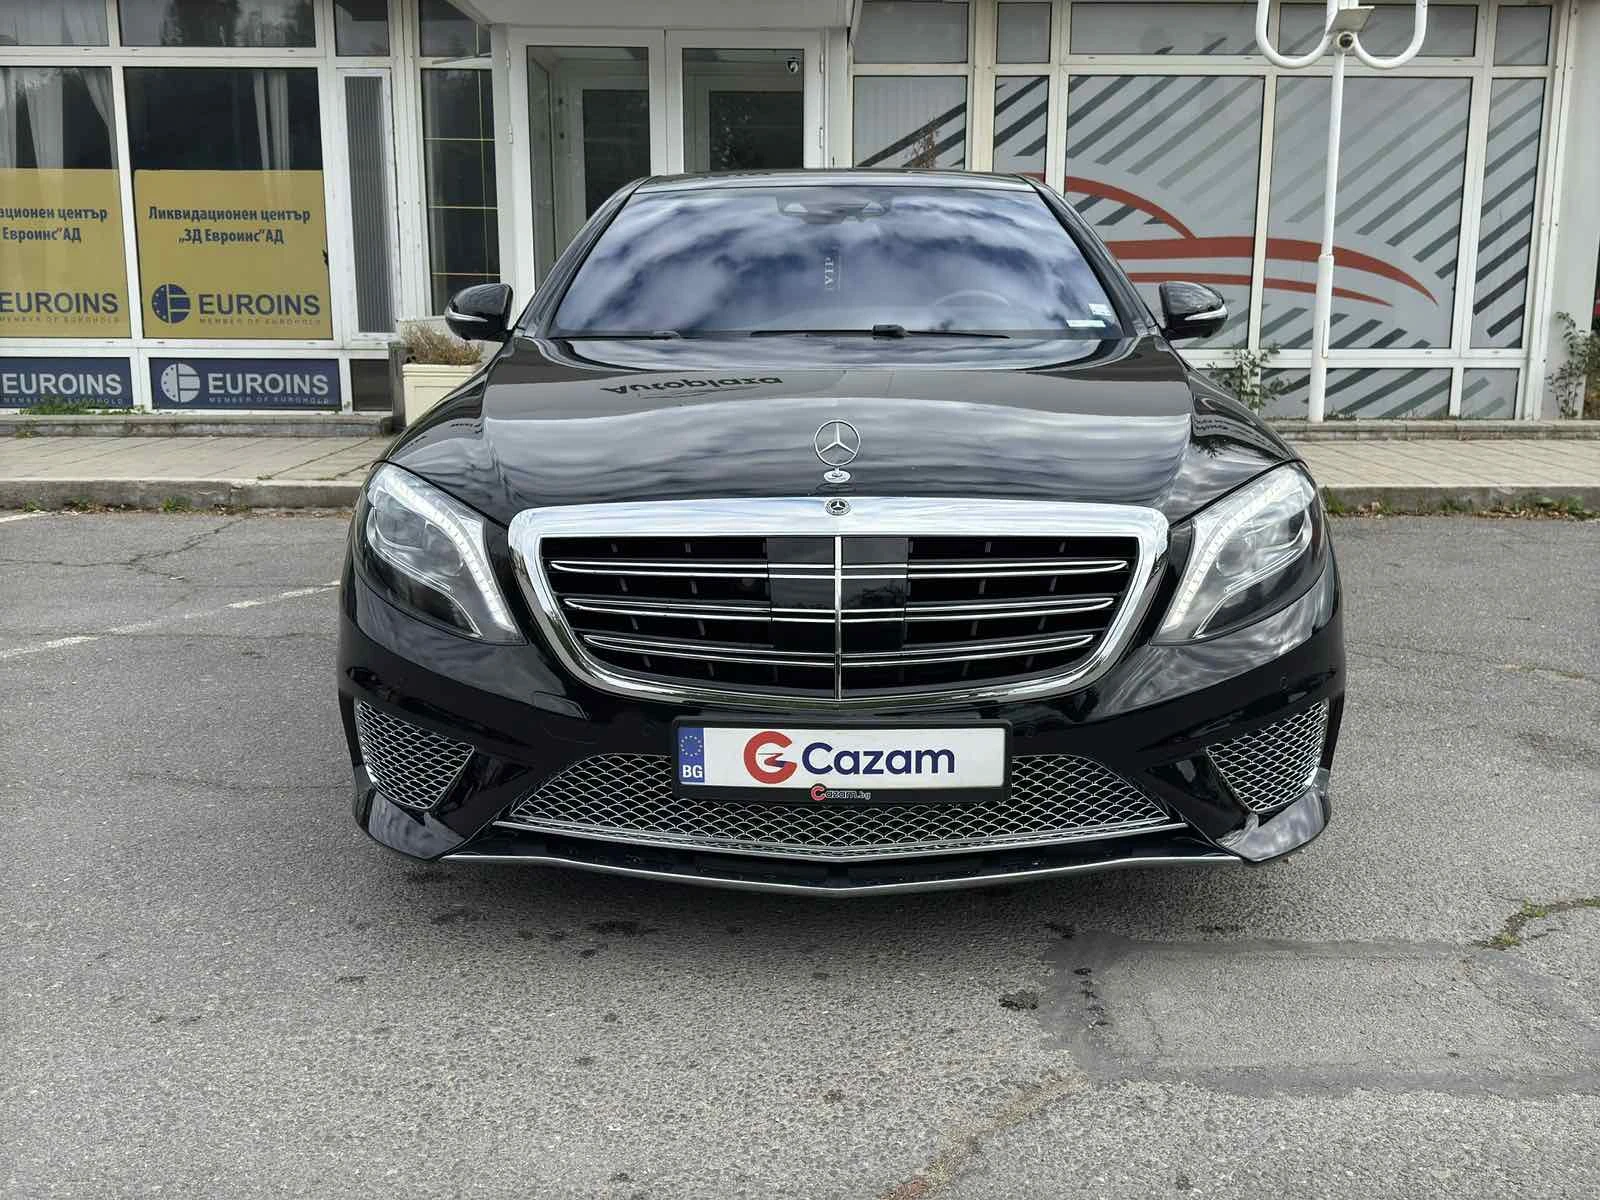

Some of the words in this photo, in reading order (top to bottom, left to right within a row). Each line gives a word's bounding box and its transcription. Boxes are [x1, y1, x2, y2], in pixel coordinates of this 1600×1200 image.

[58, 208, 108, 222] център
[148, 206, 258, 222] Ликвидационен
[260, 209, 311, 224] център
[0, 292, 118, 314] EUROINS
[198, 294, 320, 316] EUROINS
[2, 373, 122, 395] EUROINS
[207, 373, 329, 395] EUROINS
[802, 742, 955, 775] Cazam
[682, 765, 703, 779] BG
